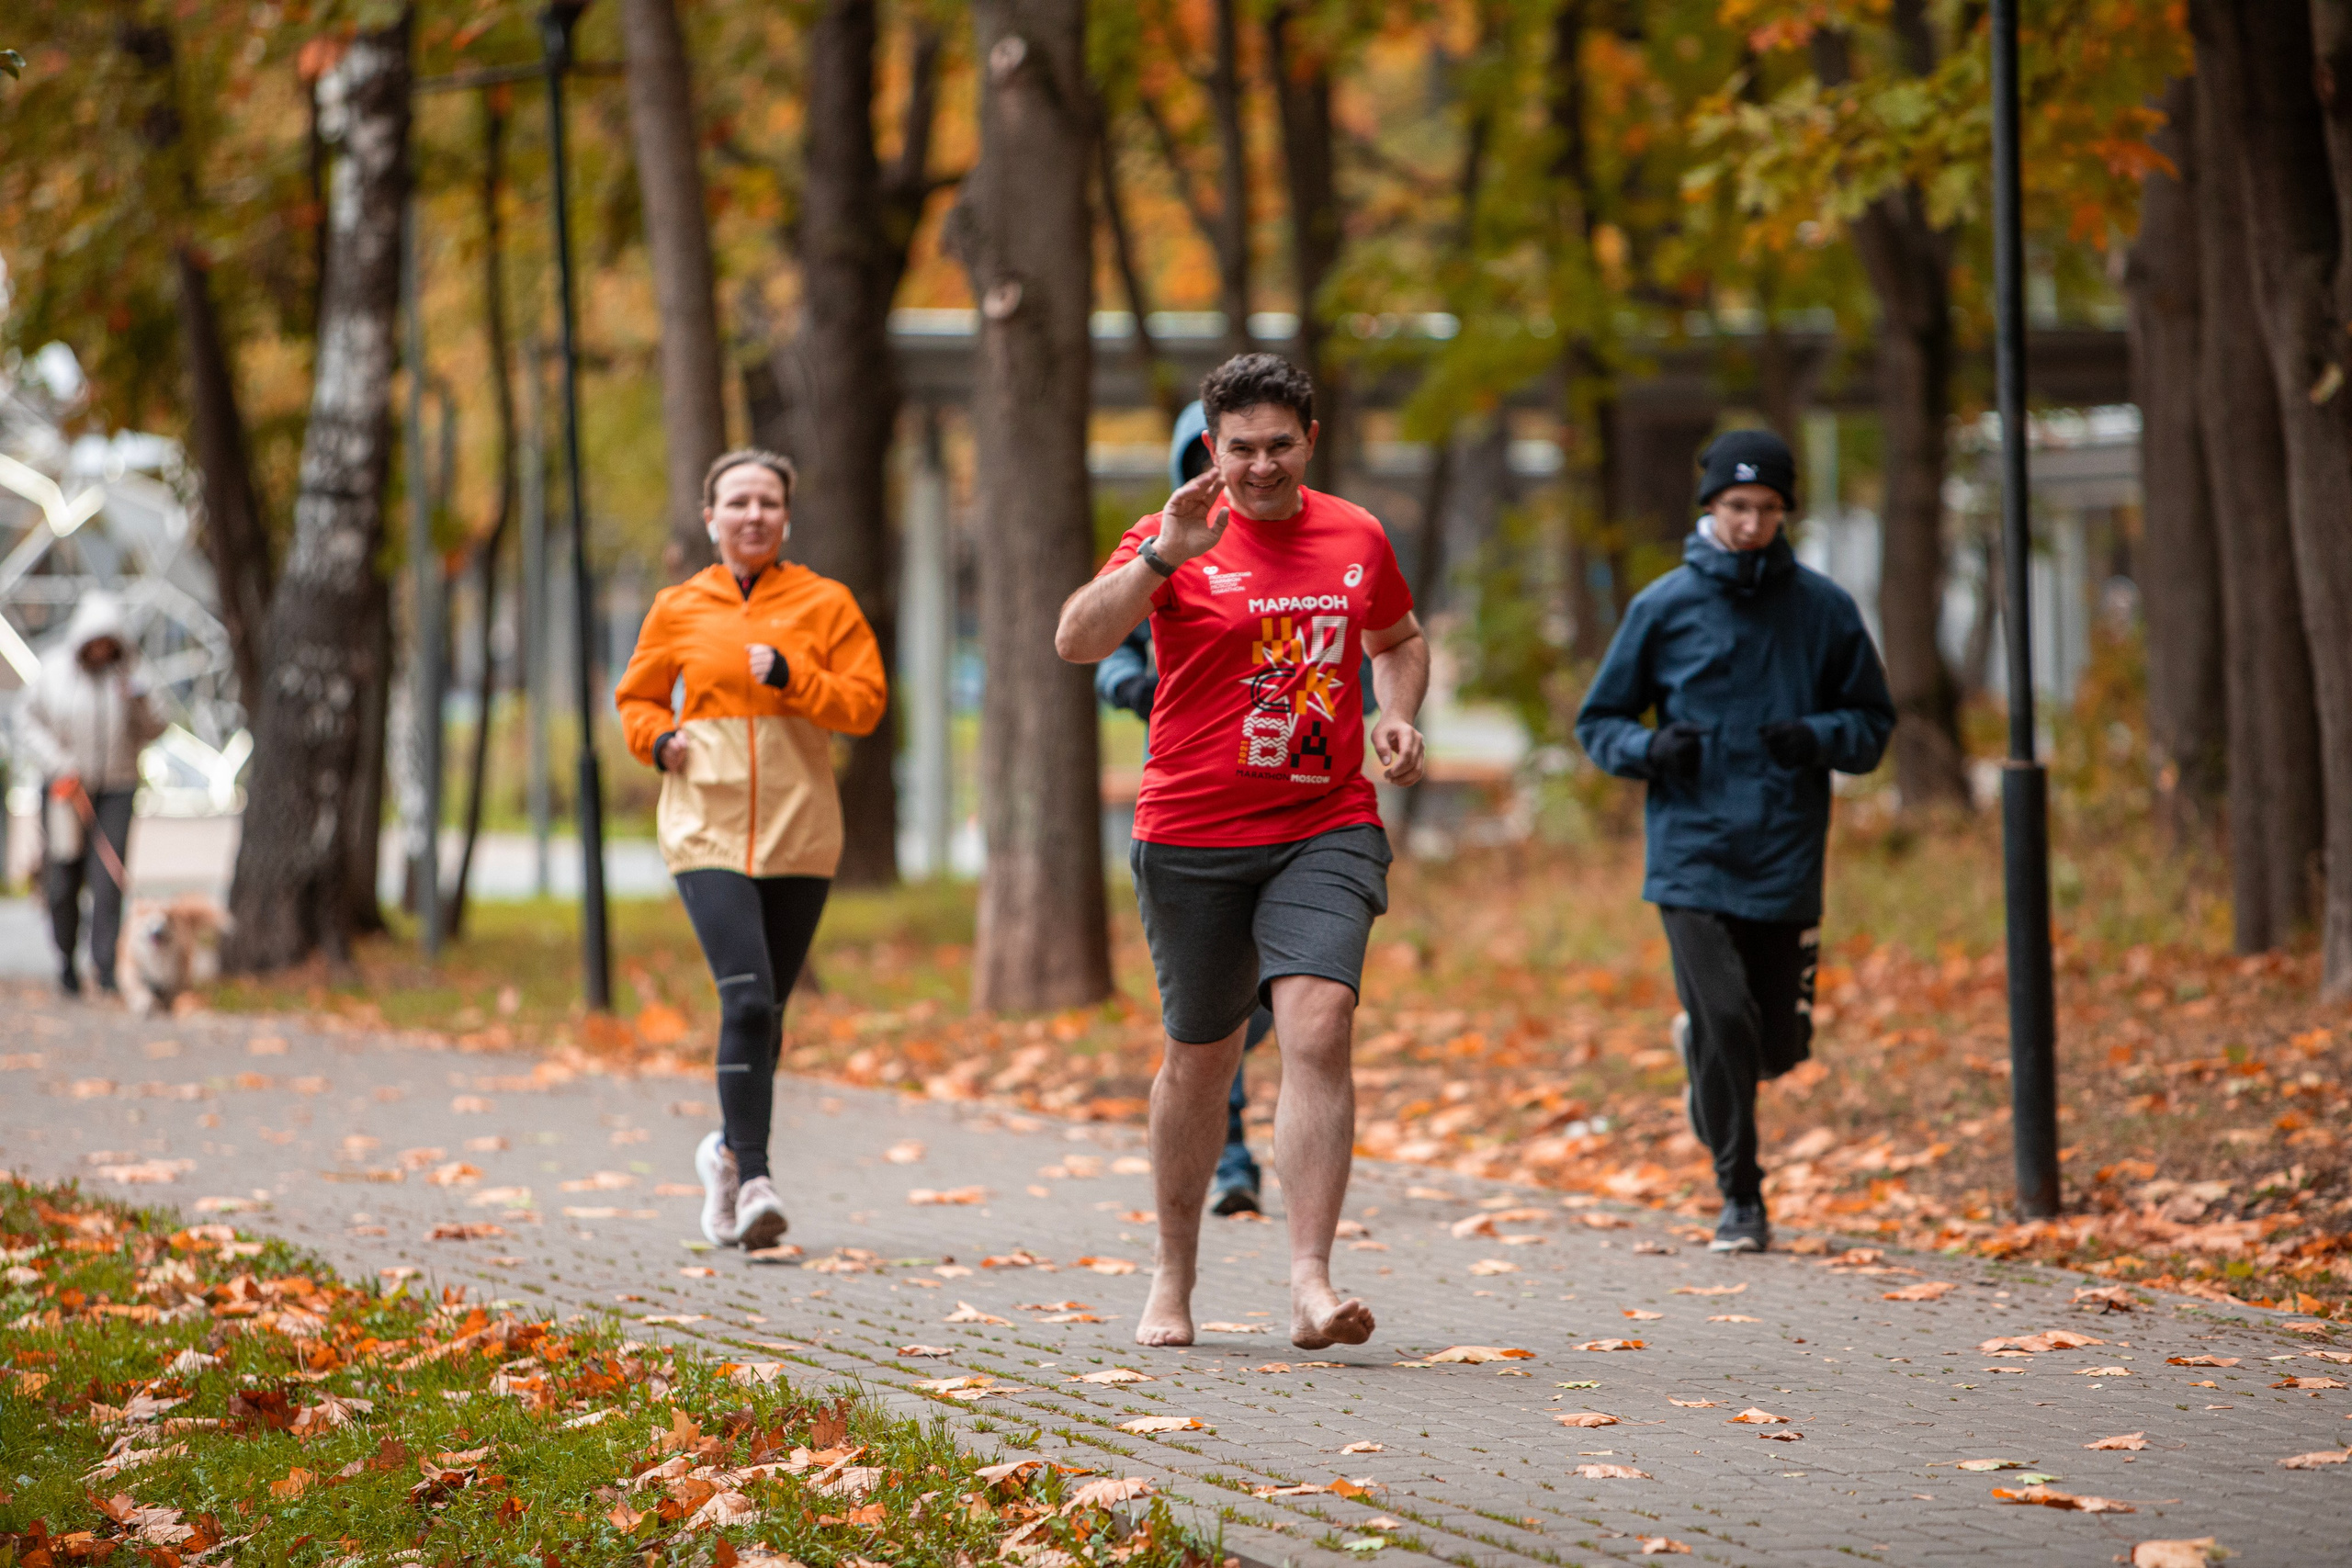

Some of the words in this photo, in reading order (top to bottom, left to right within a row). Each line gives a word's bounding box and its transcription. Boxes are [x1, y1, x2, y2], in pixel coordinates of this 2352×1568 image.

[1248, 594, 1349, 614] МАРАФОН
[1238, 739, 1249, 764] 2021
[1235, 769, 1289, 781] MARATHON
[1290, 773, 1331, 784] MOSCOW
